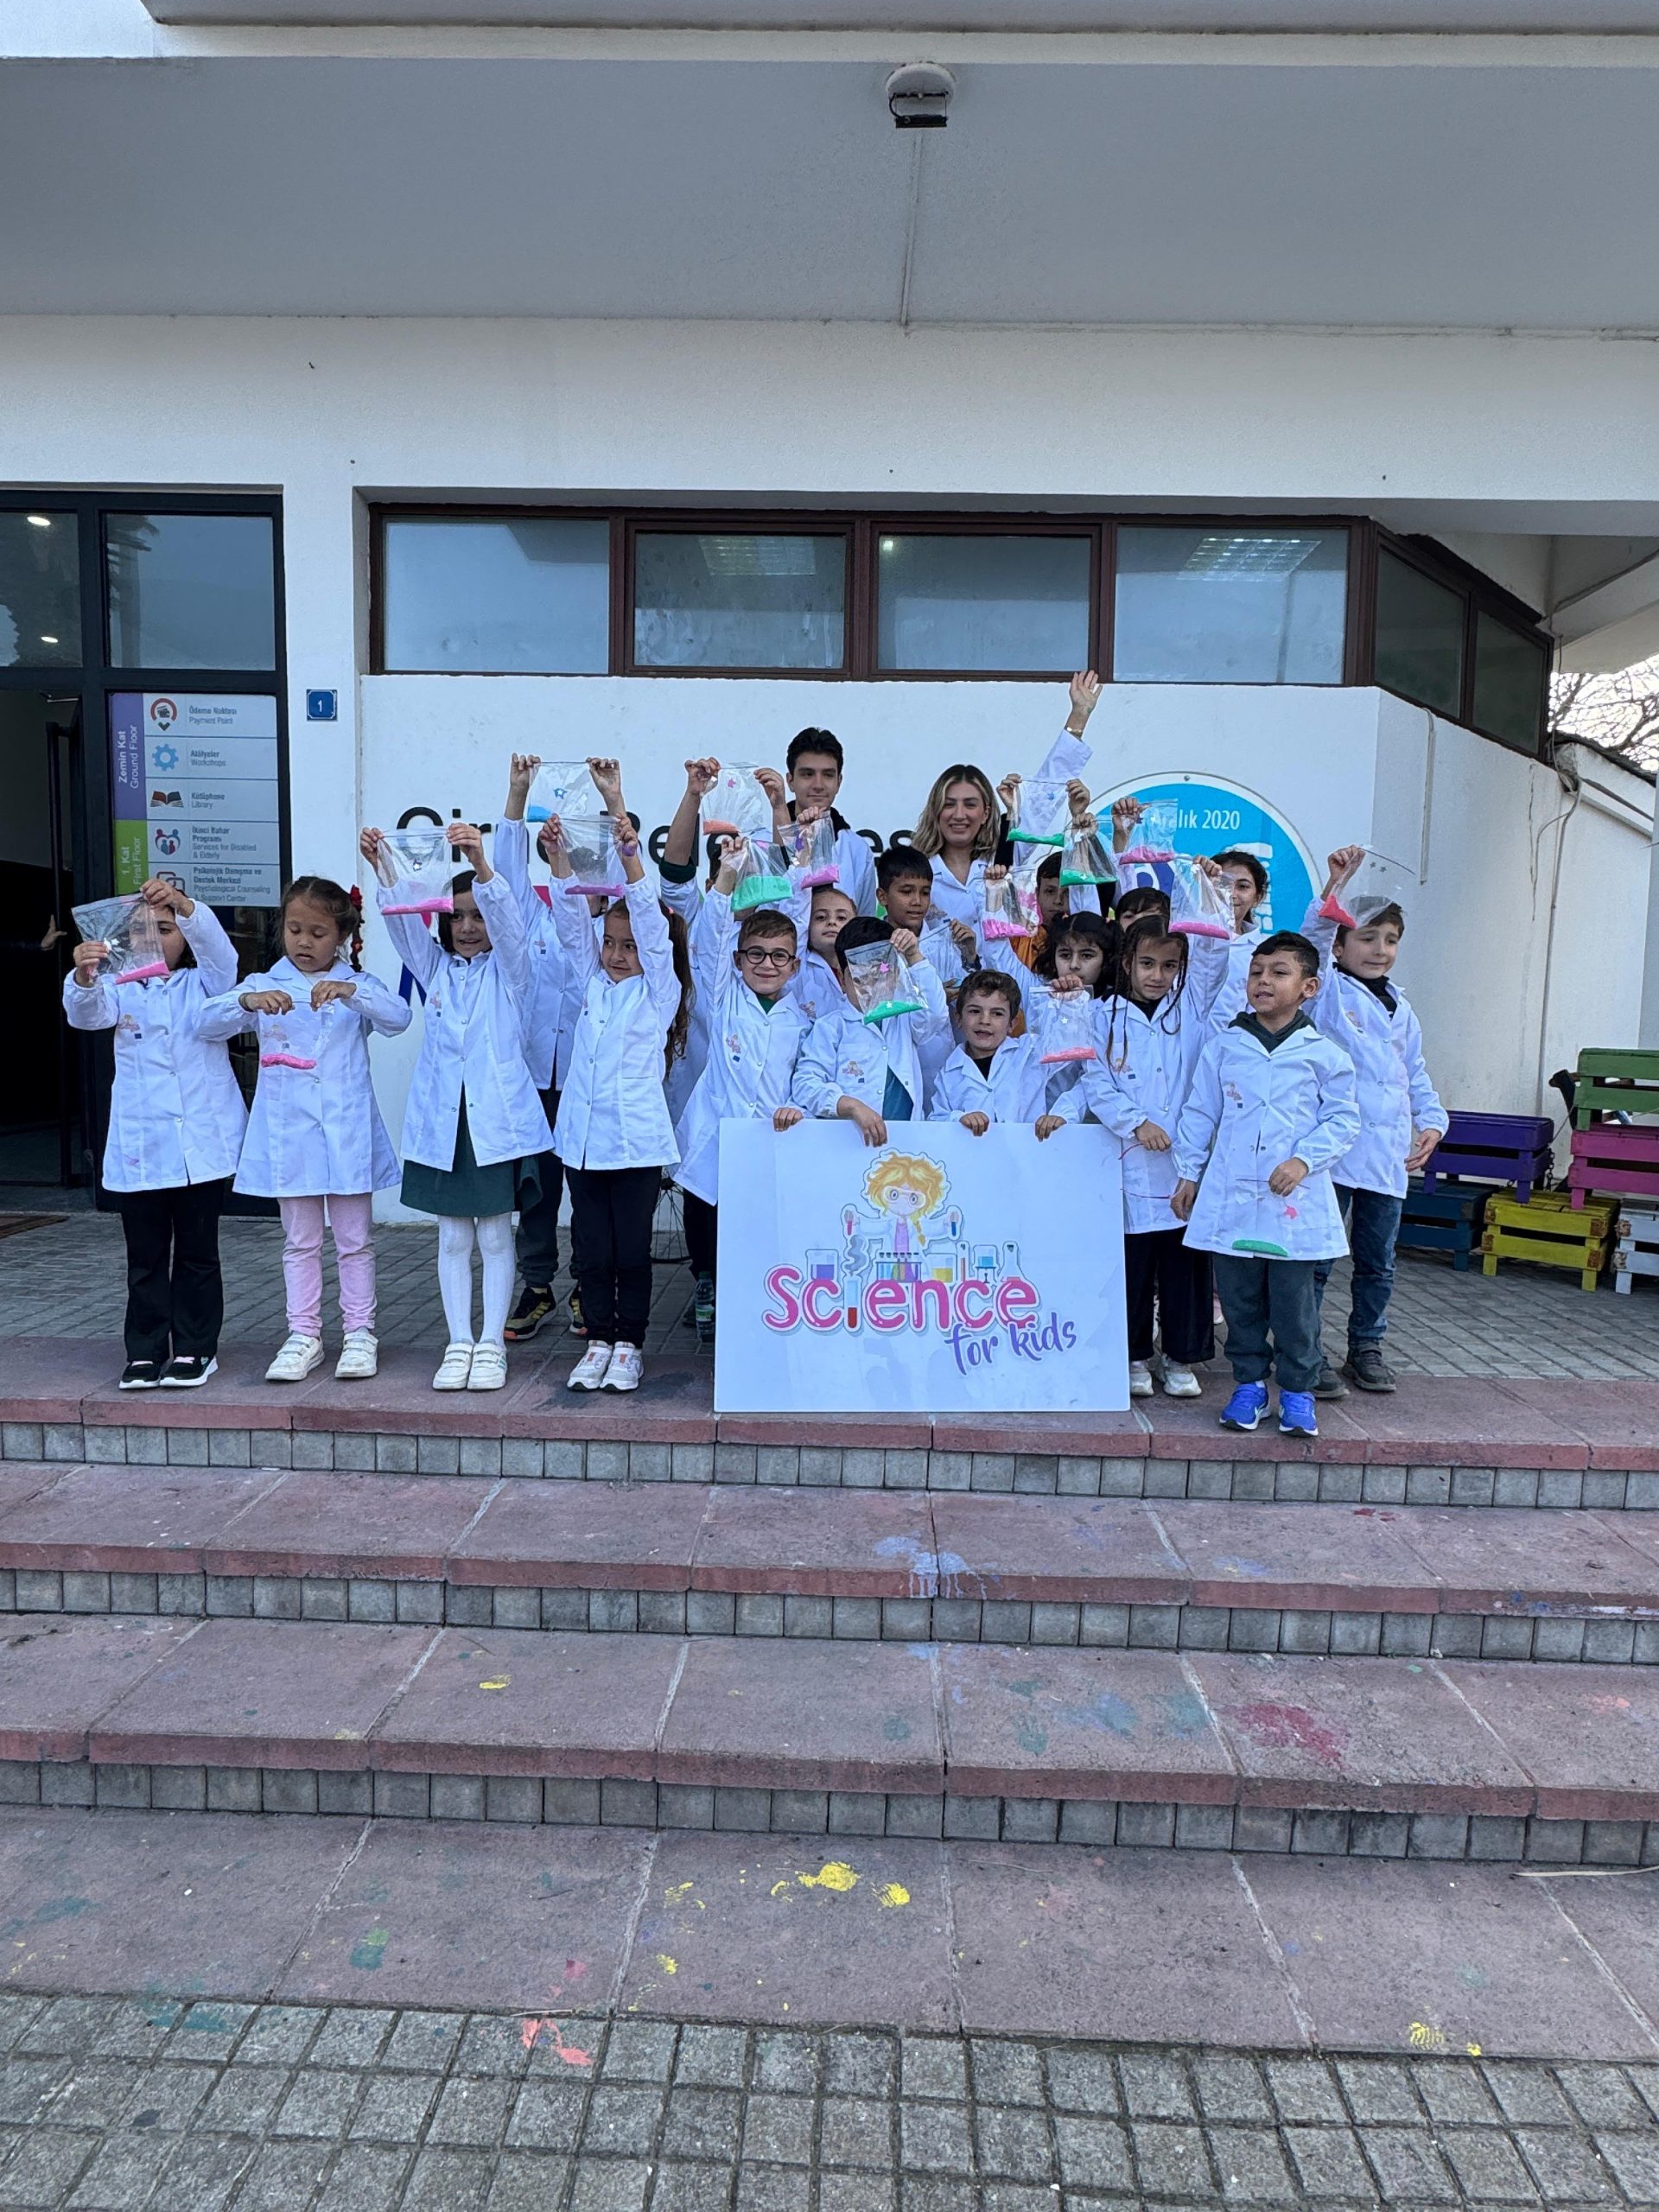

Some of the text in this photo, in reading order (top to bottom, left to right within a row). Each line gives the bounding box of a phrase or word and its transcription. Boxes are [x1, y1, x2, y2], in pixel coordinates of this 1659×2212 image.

[188, 705, 212, 715] Ödeme
[317, 699, 323, 713] 1
[188, 716, 215, 726] Payment
[117, 730, 128, 784] Zemin Kat
[129, 725, 139, 789] Ground Floor
[190, 759, 227, 767] Workshops
[191, 791, 226, 802] Kütüphane
[191, 801, 213, 810] Library
[1201, 810, 1242, 830] 2020
[211, 826, 231, 835] Bahar
[230, 843, 257, 852] Disabled
[120, 846, 130, 863] Kat
[200, 851, 220, 860] Elderly
[131, 836, 142, 885] First Floor
[216, 876, 241, 885] Merkezi
[194, 885, 236, 893] Psychological
[200, 893, 226, 903] Support
[764, 1266, 1039, 1331] Science
[944, 1311, 1077, 1376] for kids
